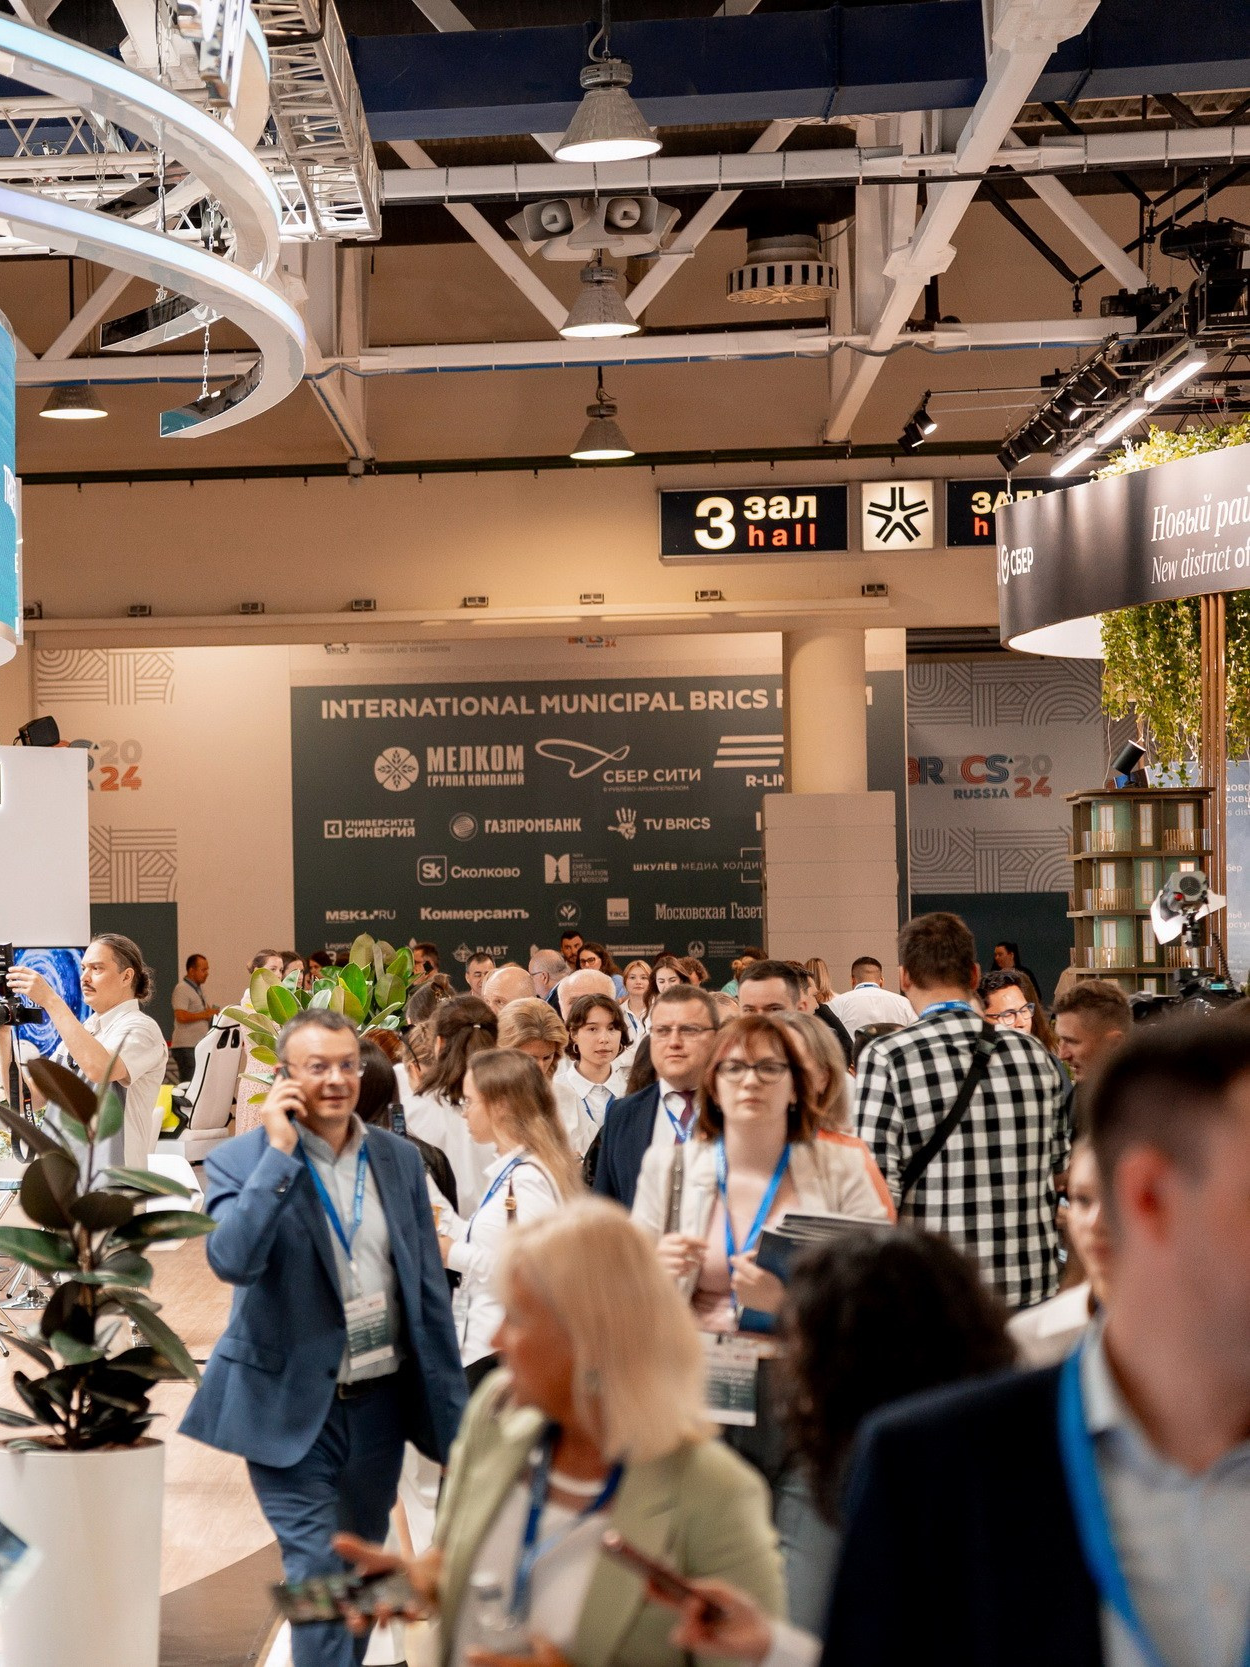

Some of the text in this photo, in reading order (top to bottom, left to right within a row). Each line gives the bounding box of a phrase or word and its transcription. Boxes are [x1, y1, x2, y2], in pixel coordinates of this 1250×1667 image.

[694, 495, 817, 550] 3 зал
[1150, 493, 1212, 542] Новый
[748, 523, 816, 547] hall
[1010, 546, 1034, 576] СБЕР
[1150, 555, 1178, 584] New
[1181, 543, 1232, 579] district
[321, 696, 535, 720] INTERNATIONAL
[540, 690, 684, 715] MUNICIPAL
[689, 689, 769, 712] BRICS
[100, 739, 143, 765] 20
[426, 745, 525, 773] МЕЛКОМ
[1013, 755, 1053, 776] 20
[100, 766, 143, 792] 24
[427, 772, 525, 788] ГРУППА КОМПАНИЙ
[603, 768, 701, 783] СБЕР СИТИ
[953, 787, 1010, 799] RUSSIA
[1013, 777, 1053, 798] 24
[345, 819, 416, 828] УНИВЕРСИТЕТ
[345, 827, 416, 839] СИНЕРГИЯ
[484, 818, 582, 834] ГАЗПРОМБАНК
[643, 817, 711, 831] TV BRICS
[421, 862, 442, 879] Sk
[450, 865, 521, 879] Сколково
[633, 861, 678, 872] ШКУЛЁВ
[681, 862, 718, 872] МЕДИА
[420, 907, 530, 922] Коммерсантъ
[655, 902, 763, 921] Московская Газет
